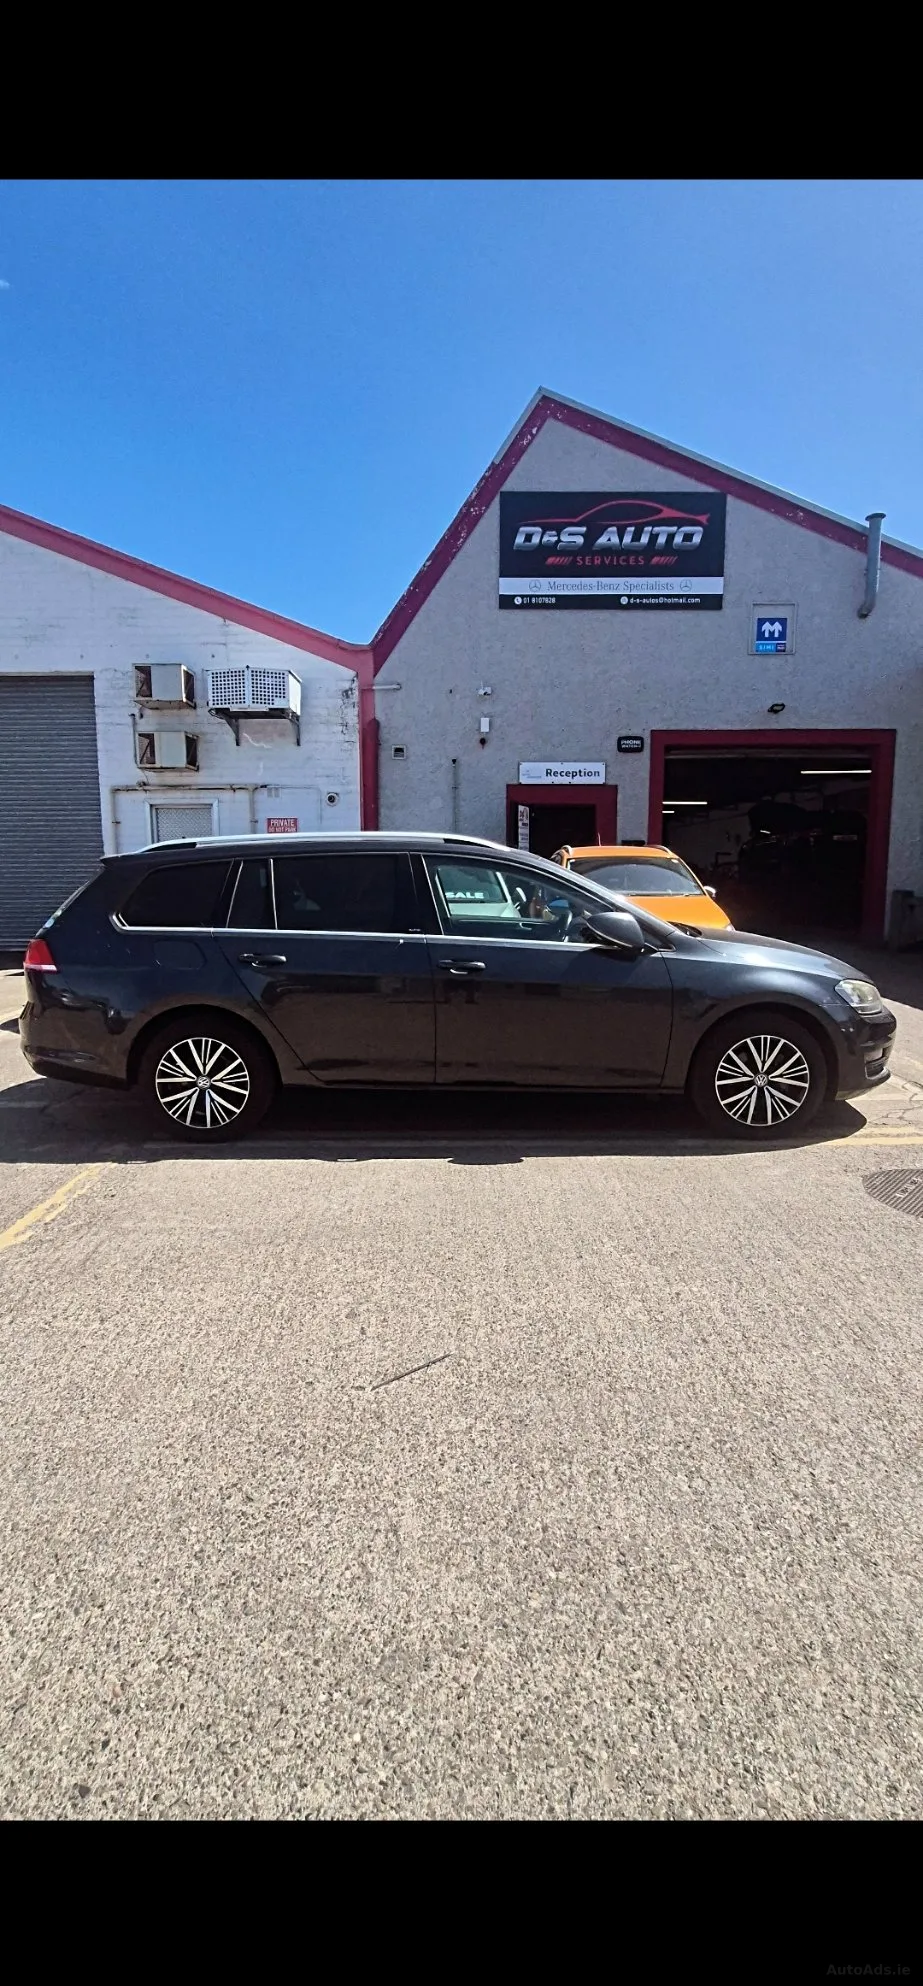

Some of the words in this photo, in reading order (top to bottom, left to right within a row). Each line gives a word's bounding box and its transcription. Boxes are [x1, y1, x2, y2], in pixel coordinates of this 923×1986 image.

[513, 526, 587, 551] D&S
[592, 526, 704, 551] AUTO
[576, 556, 645, 566] SERVICES
[547, 581, 620, 591] Mercedes-Benz
[623, 580, 674, 593] Specialists
[545, 768, 600, 779] Reception
[445, 891, 485, 899] SALE
